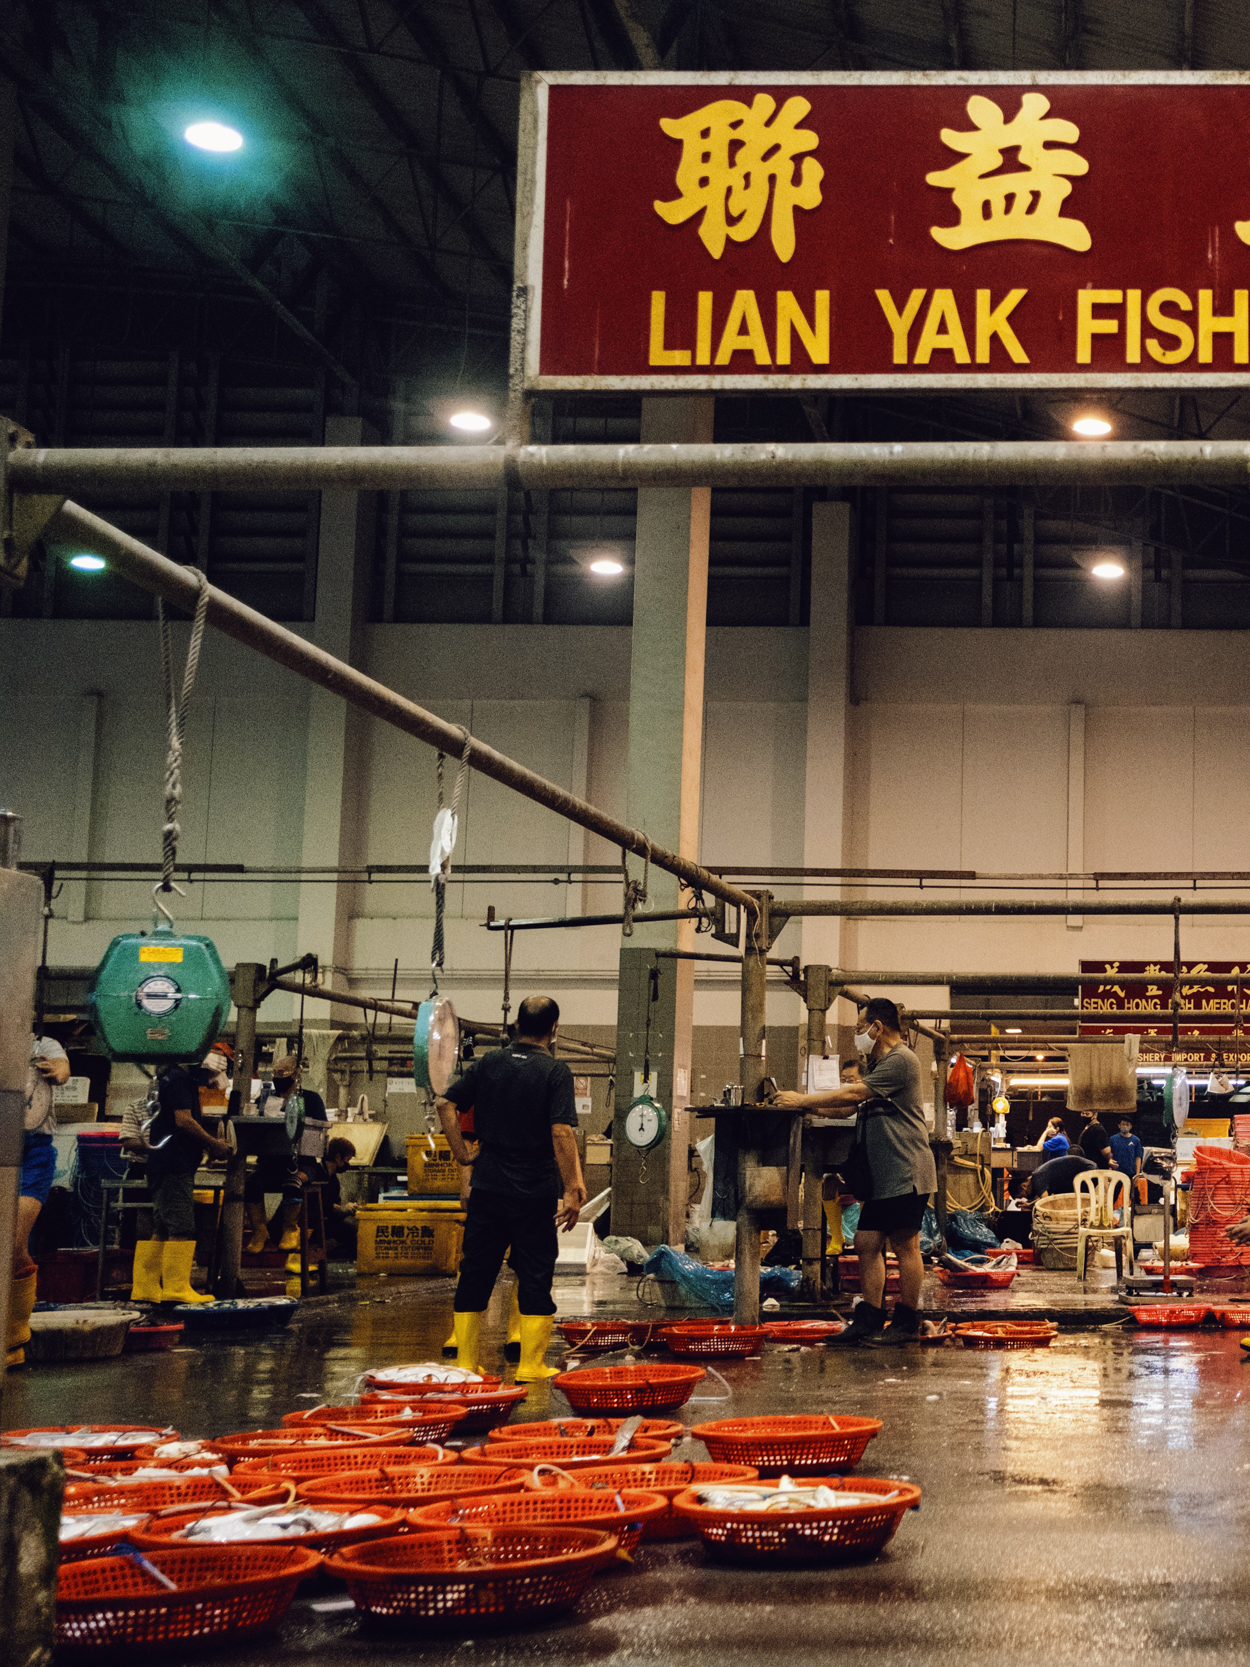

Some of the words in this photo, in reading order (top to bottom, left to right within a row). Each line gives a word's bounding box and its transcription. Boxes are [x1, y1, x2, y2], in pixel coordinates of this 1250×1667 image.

[649, 289, 831, 366] LIAN
[875, 289, 1030, 365] YAK
[1075, 287, 1250, 365] FISH
[1083, 999, 1117, 1010] SENG
[1124, 999, 1161, 1010] HONG
[1172, 1053, 1205, 1062] IMPORT
